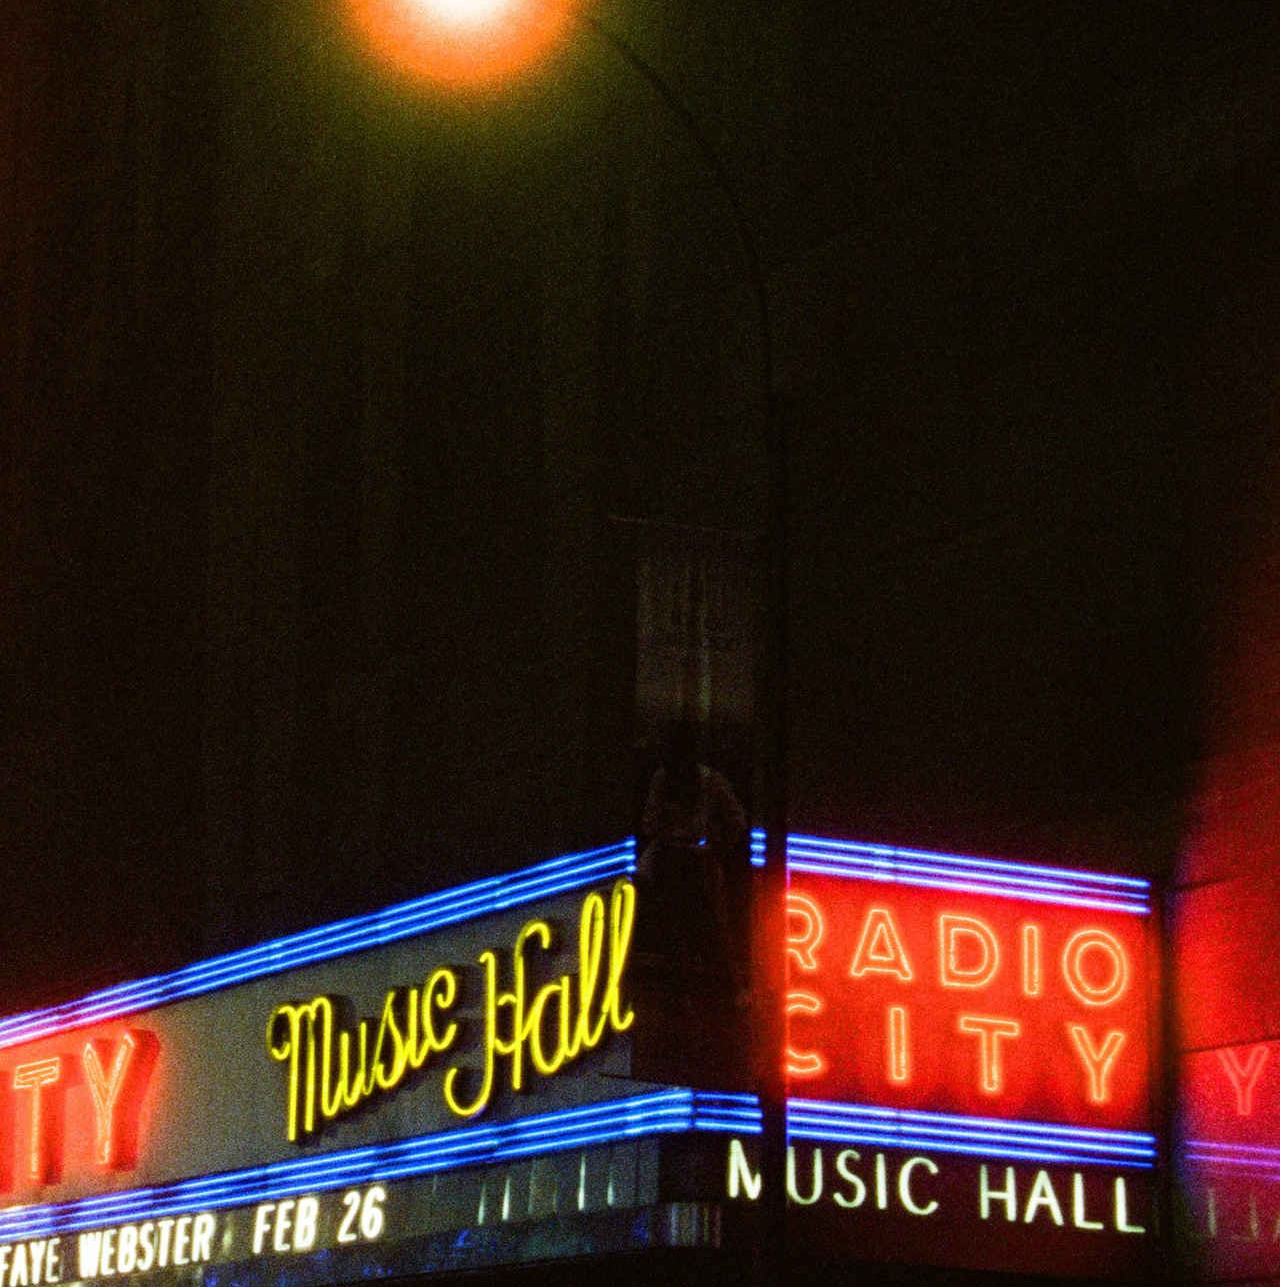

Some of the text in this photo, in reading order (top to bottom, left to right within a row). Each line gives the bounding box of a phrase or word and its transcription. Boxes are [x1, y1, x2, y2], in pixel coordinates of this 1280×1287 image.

[267, 877, 637, 1143] Music Hall
[77, 1212, 217, 1279] WEBSTER
[252, 1195, 320, 1254] FEB
[337, 1186, 387, 1243] 26
[979, 1164, 1146, 1236] HALL
